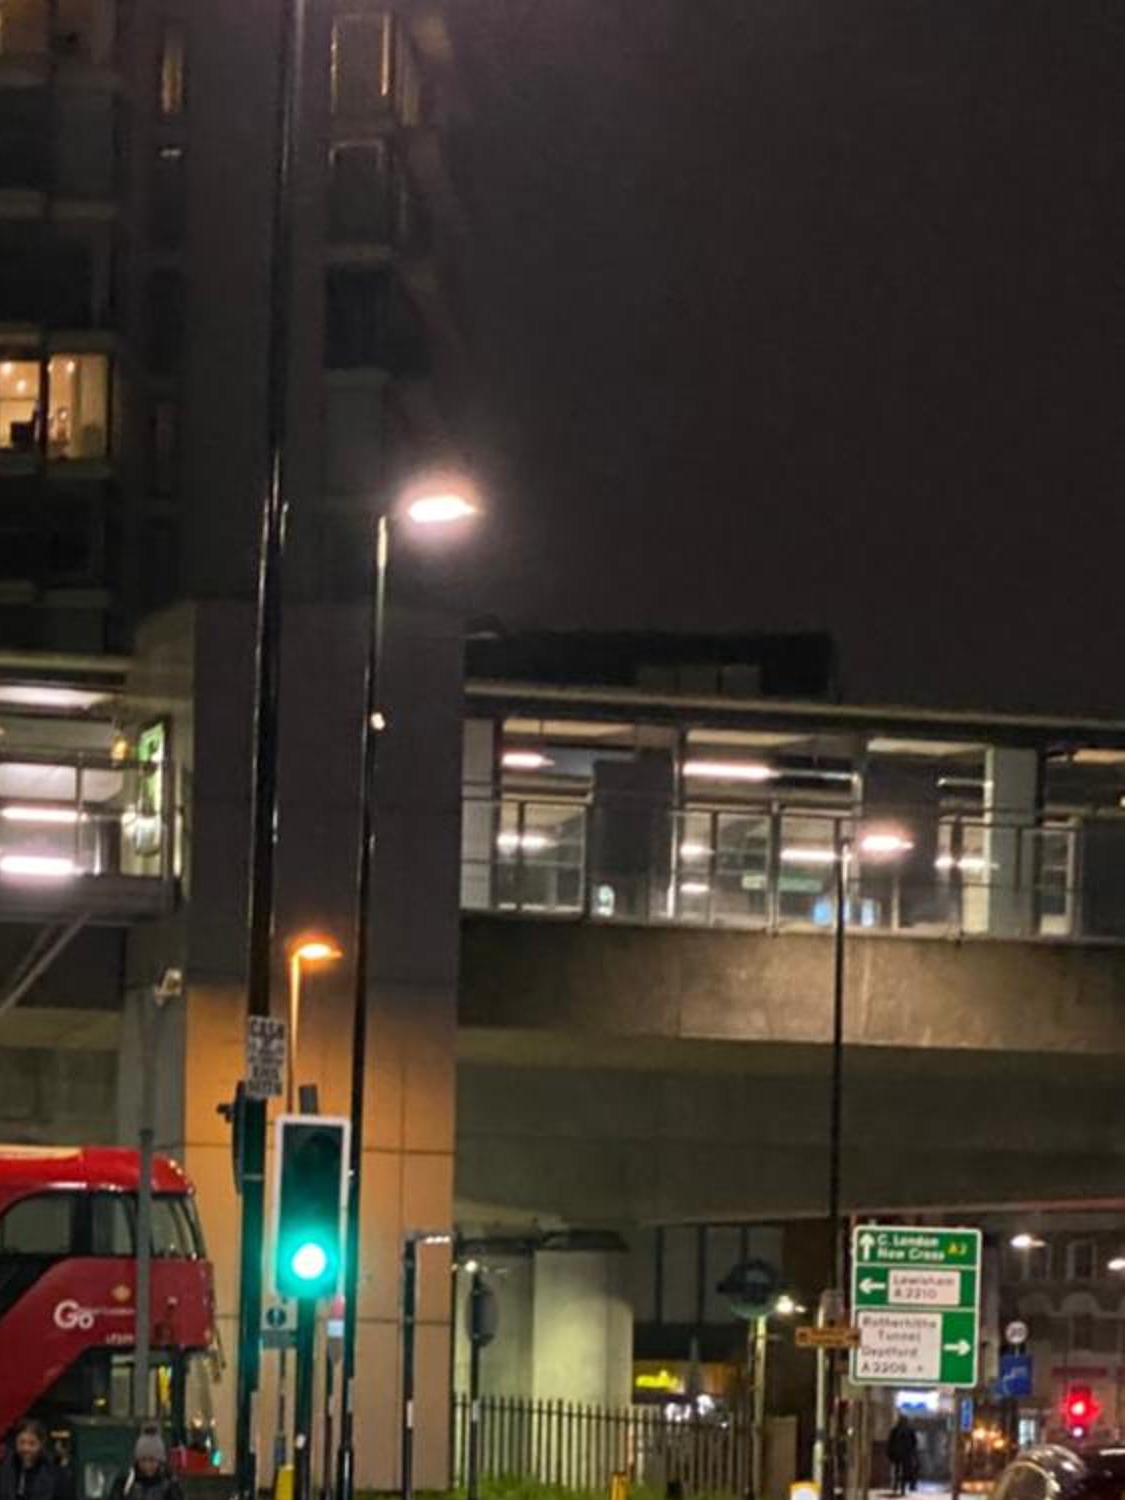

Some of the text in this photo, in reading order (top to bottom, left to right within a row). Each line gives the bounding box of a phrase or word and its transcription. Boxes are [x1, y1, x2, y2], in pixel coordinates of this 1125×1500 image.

[894, 1235, 939, 1247] London
[878, 1248, 945, 1260] New Cross
[893, 1275, 955, 1286] Lewisham
[53, 1300, 94, 1330] Go
[862, 1316, 937, 1328] Rotherhithe
[878, 1331, 921, 1341] Tunnel
[861, 1345, 918, 1357] Deptford
